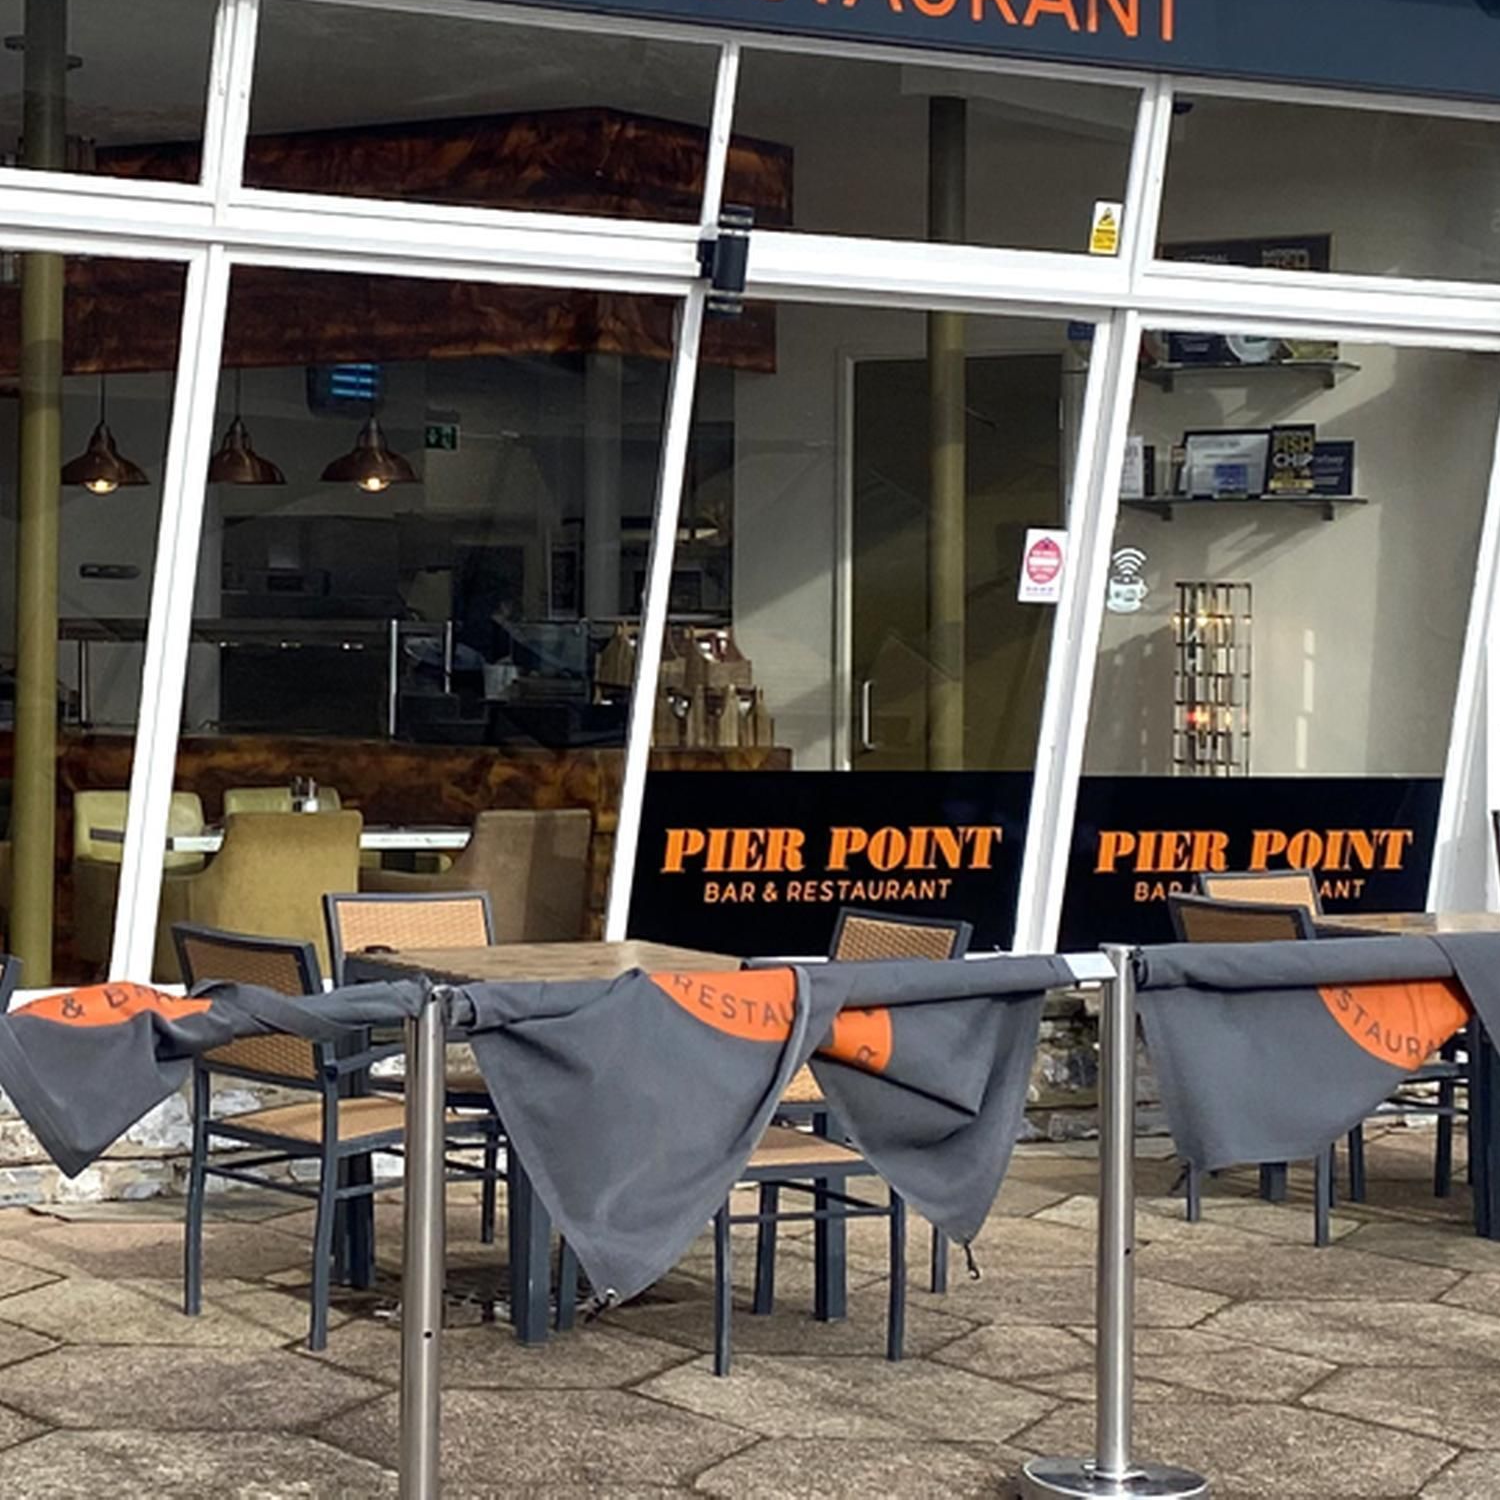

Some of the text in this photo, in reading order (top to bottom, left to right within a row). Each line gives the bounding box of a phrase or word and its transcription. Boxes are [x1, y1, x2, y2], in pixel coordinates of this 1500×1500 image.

[661, 826, 1003, 873] PIER POINT
[1094, 829, 1414, 873] PIER POINT
[704, 879, 952, 903] BAR & RESTAURANT
